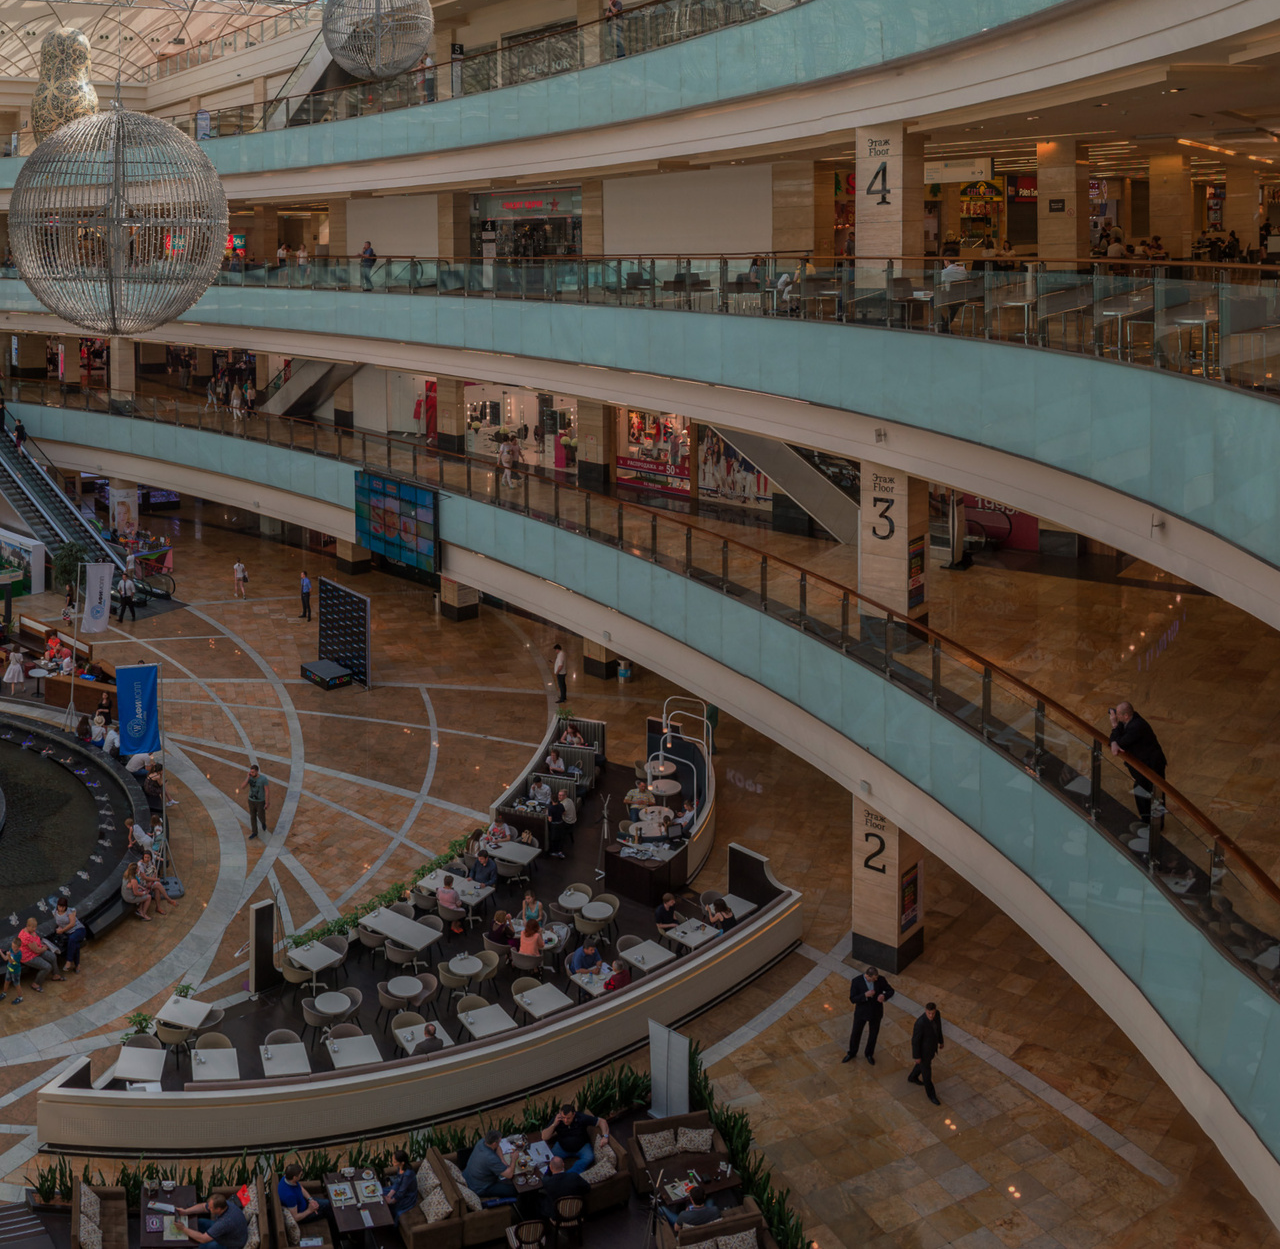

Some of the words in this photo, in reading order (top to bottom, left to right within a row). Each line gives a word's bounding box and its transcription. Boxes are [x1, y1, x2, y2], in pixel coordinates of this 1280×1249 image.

[454, 45, 460, 54] 5
[868, 138, 890, 147] Этаж
[869, 147, 890, 156] Floor
[866, 161, 891, 206] 4
[486, 222, 491, 230] 4
[627, 460, 657, 469] РАСПРОДАЖА
[666, 465, 675, 474] 50
[872, 473, 895, 484] Этаж
[873, 482, 894, 492] Floor
[872, 497, 895, 540] 3
[864, 810, 887, 823] Этаж
[865, 818, 886, 831] Floor
[864, 833, 886, 874] 2
